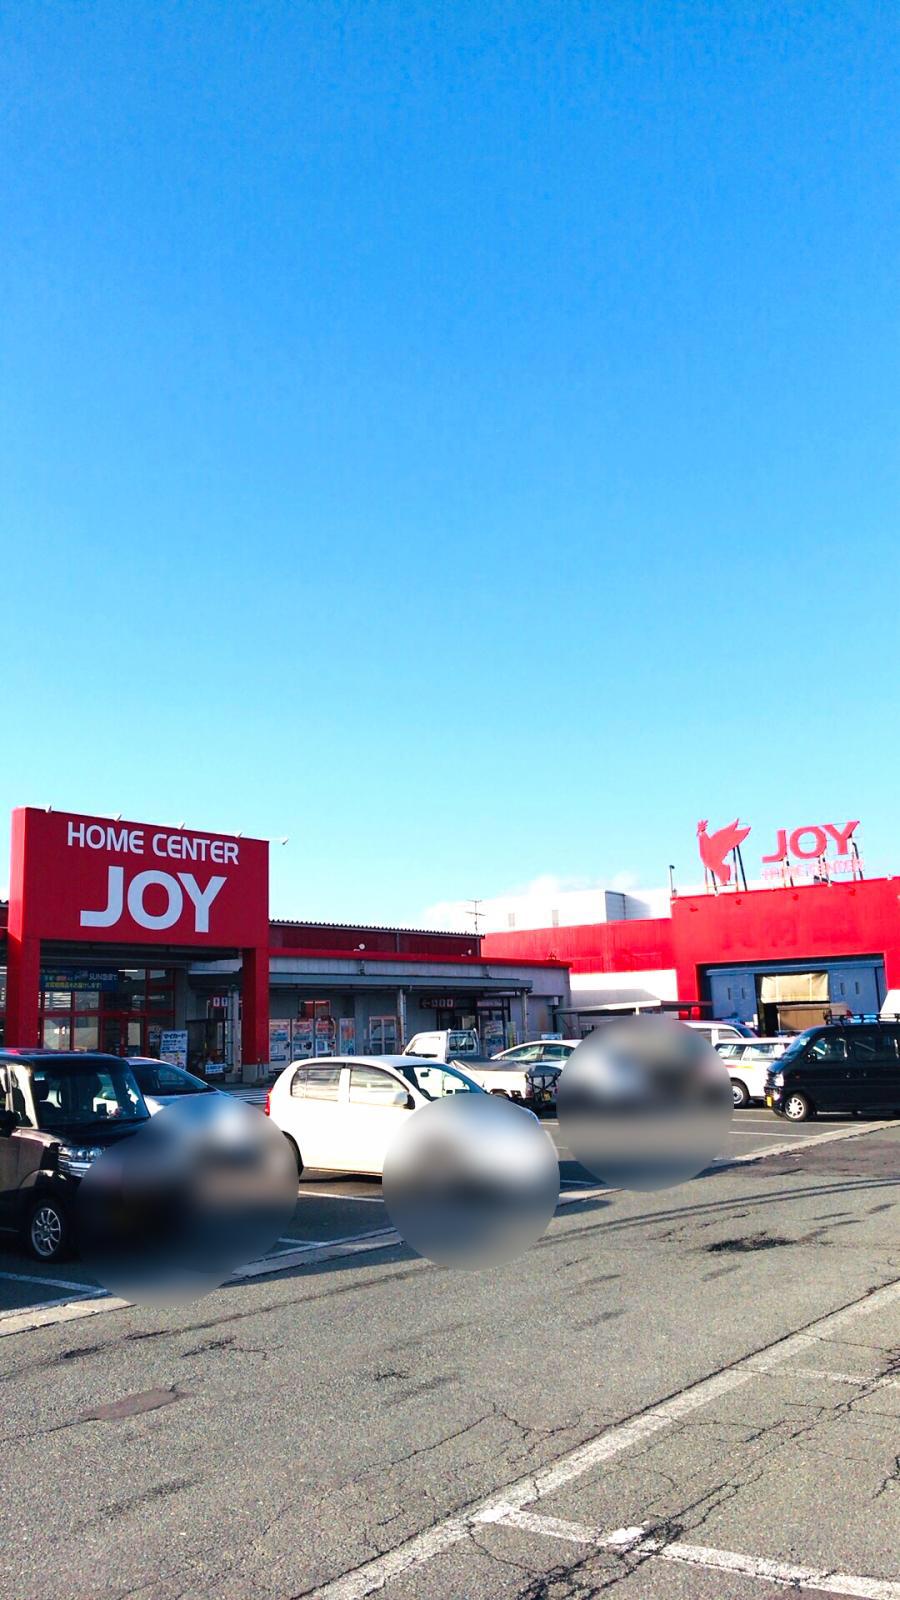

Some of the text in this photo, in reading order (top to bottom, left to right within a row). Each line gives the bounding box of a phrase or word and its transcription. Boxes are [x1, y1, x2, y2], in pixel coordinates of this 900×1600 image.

[67, 821, 240, 865] HOME CENTER
[762, 820, 860, 863] JOY
[79, 865, 228, 933] JOY
